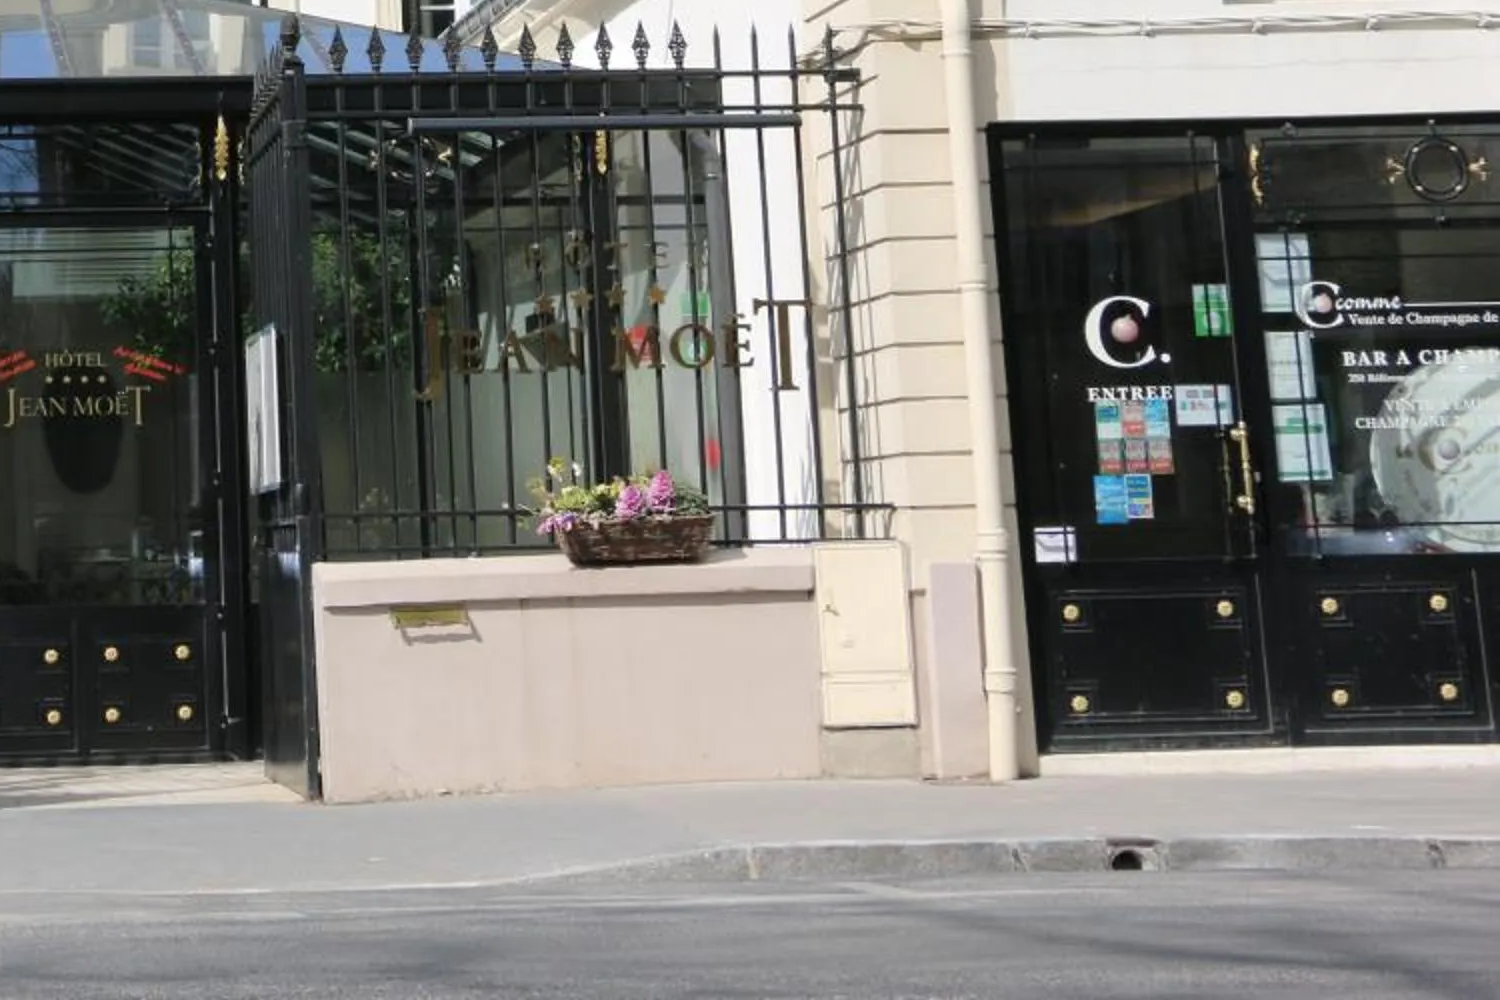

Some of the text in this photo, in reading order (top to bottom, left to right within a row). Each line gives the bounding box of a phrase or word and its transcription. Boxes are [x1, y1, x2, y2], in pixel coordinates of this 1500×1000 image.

[1348, 313, 1386, 325] Vente
[1388, 312, 1403, 325] de
[1405, 311, 1480, 327] Champagne
[45, 349, 108, 367] HÔTEL
[414, 306, 584, 402] JEAN
[1342, 351, 1389, 366] BAR
[1396, 351, 1411, 365] A
[1088, 385, 1172, 402] ENTREE
[4, 385, 152, 427] JEAN MOËT
